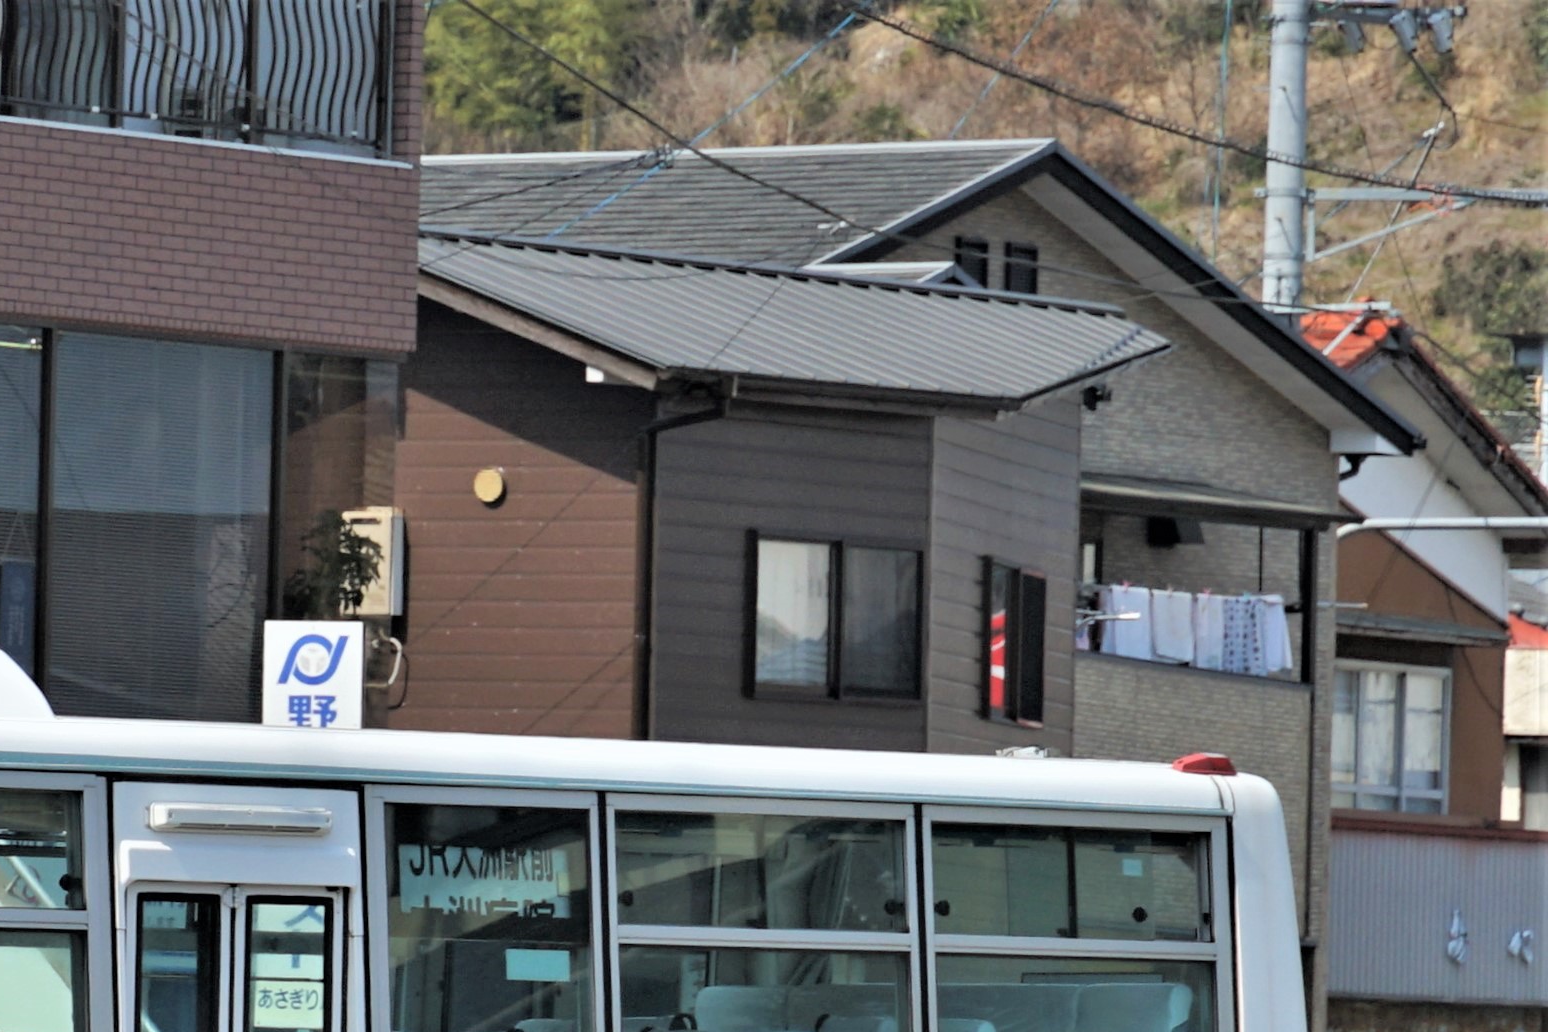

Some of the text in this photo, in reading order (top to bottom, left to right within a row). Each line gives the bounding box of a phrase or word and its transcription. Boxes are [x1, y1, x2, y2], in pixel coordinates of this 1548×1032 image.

[288, 695, 337, 727] 野
[258, 988, 323, 1011] あさぎり
